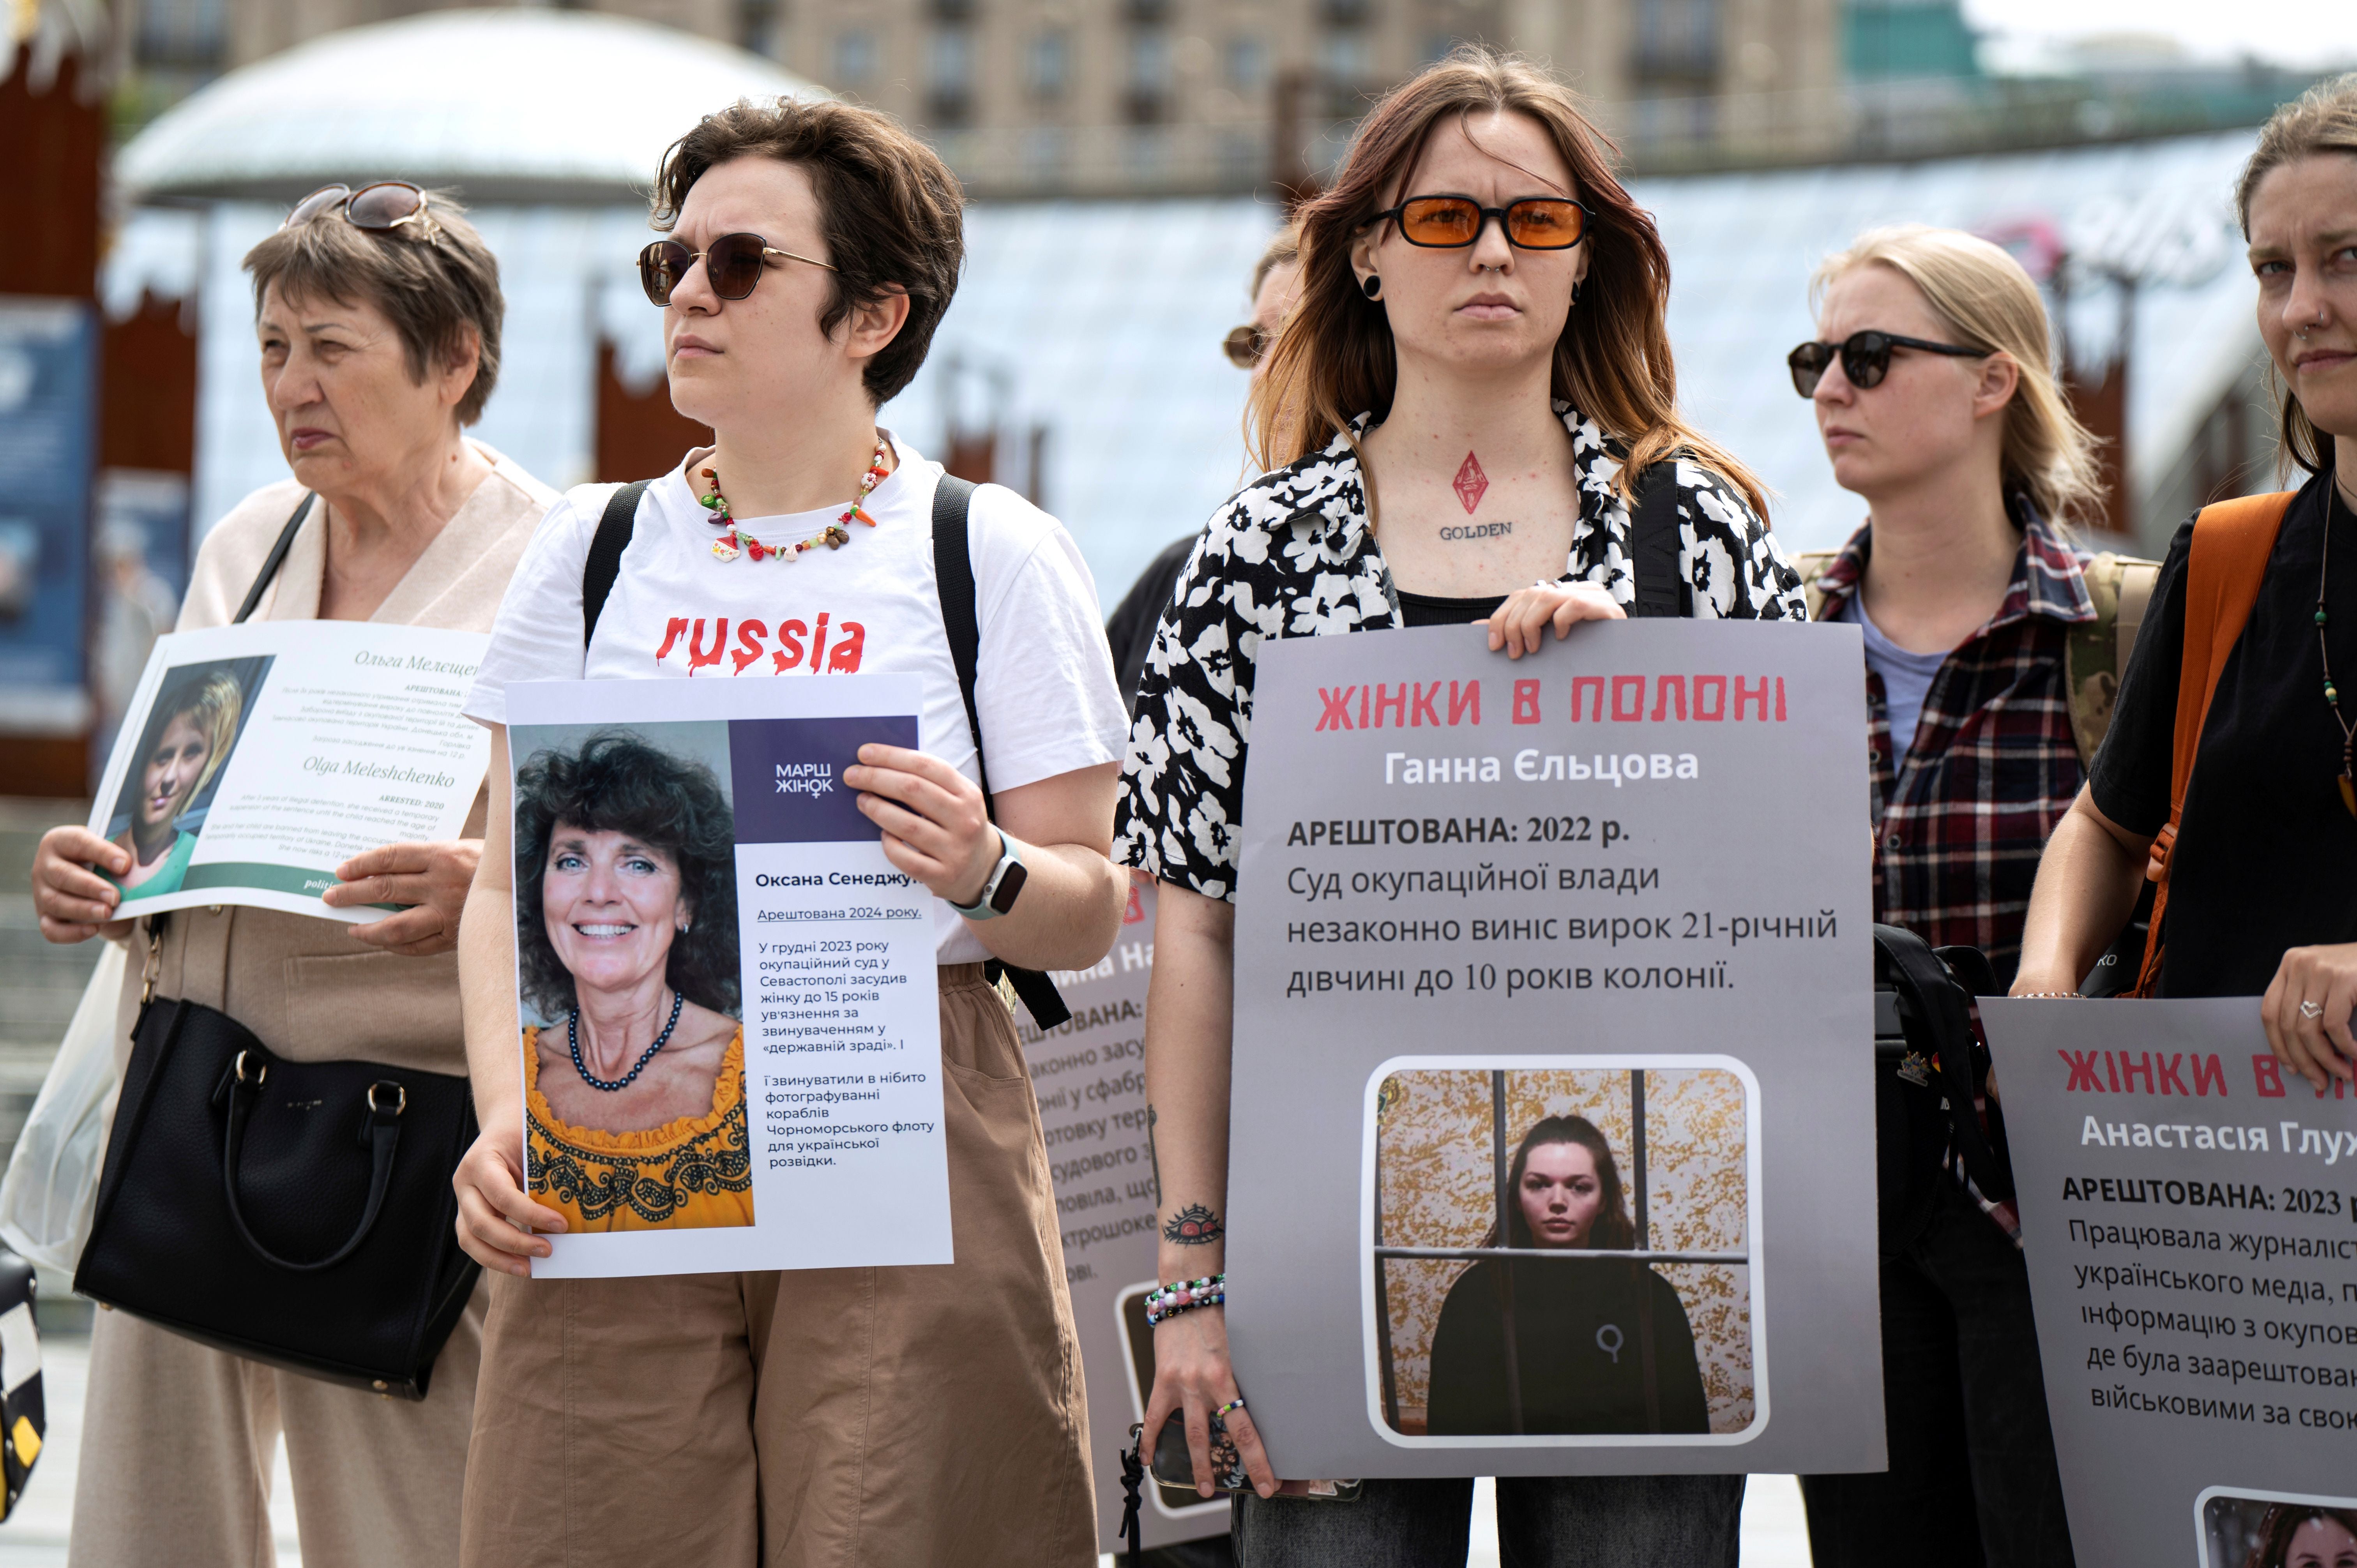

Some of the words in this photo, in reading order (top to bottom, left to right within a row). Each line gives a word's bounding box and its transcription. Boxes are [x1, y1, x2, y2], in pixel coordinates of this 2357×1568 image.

[1440, 522, 1512, 540] GOLDEN
[656, 612, 865, 677] russia
[354, 650, 403, 667] Ольга
[405, 685, 463, 697] АРЕШТОВАНА:
[1315, 680, 1481, 732] ЖІНКИ
[1512, 678, 1541, 725] В
[1571, 675, 1787, 723] ПОЛОНІ
[303, 756, 339, 776] Olga
[342, 759, 454, 788] Meleshchenko
[776, 763, 831, 777] МАРШ
[1386, 752, 1500, 784] Ганна
[1514, 749, 1698, 788] Єльцова
[776, 779, 834, 799] ЖІНОК
[379, 795, 423, 807] ARRESTED:
[424, 802, 444, 810] 2020
[1287, 817, 1518, 846] АРЕШТОВАНА:
[1527, 816, 1591, 842] 2022
[1602, 820, 1629, 849] р.
[756, 874, 823, 887] Оксана
[829, 872, 922, 887] Сенеджу
[1288, 867, 1342, 902] Суд
[1352, 862, 1549, 901] окупаційної
[1559, 868, 1658, 895] влади
[757, 908, 846, 922] Арештована
[849, 906, 882, 918] 2024
[886, 907, 922, 920] року.
[1288, 920, 1460, 943] незаконно
[1472, 918, 1557, 940] виніс
[1569, 918, 1671, 947] вирок
[1682, 909, 1836, 947] 21-річній
[759, 943, 768, 954] У
[772, 941, 816, 955] грудні
[820, 941, 852, 952] 2023
[856, 942, 889, 954] року
[760, 957, 850, 972] окупаційний
[854, 959, 878, 970] суд
[882, 959, 889, 969] у
[760, 973, 846, 987] Севастополі
[851, 975, 907, 987] засудив
[1287, 970, 1404, 998] дівчині
[1414, 969, 1453, 997] до
[1467, 964, 1496, 990] 10
[1507, 968, 1592, 998] років
[1604, 961, 1733, 989] колонії.
[761, 992, 800, 1005] жінку
[804, 994, 822, 1004] до
[825, 991, 838, 1002] 15
[842, 990, 880, 1004] років
[761, 1010, 839, 1022] ув'язнення
[844, 1009, 859, 1018] за
[762, 1026, 874, 1038] звинуваченням
[878, 1025, 886, 1036] у
[763, 1041, 845, 1055] «державній
[850, 1039, 896, 1053] зраді».
[772, 1076, 863, 1087] звинуватили
[868, 1075, 876, 1084] в
[880, 1072, 926, 1083] нібито
[2057, 1049, 2228, 1097] ЖІНКИ
[2252, 1054, 2286, 1097] В
[765, 1089, 880, 1105] фотографуванні
[767, 1107, 829, 1121] кораблів
[767, 1124, 888, 1137] Чорноморського
[892, 1121, 934, 1134] флоту
[2081, 1116, 2269, 1151] Анастасія
[768, 1143, 793, 1153] для
[797, 1138, 879, 1153] української
[770, 1156, 836, 1169] розвідки.
[2062, 1177, 2275, 1211] АРЕШТОВАНА:
[2283, 1188, 2341, 1215] 2023
[2069, 1219, 2221, 1250] Працювала
[2074, 1264, 2244, 1294] українського
[2252, 1277, 2334, 1305] медіа,
[2081, 1302, 2236, 1338] інформацію
[2243, 1319, 2256, 1338] з
[2087, 1347, 2115, 1371] де
[2123, 1346, 2180, 1376] була
[2091, 1384, 2255, 1421] військовими
[2263, 1405, 2290, 1425] за
